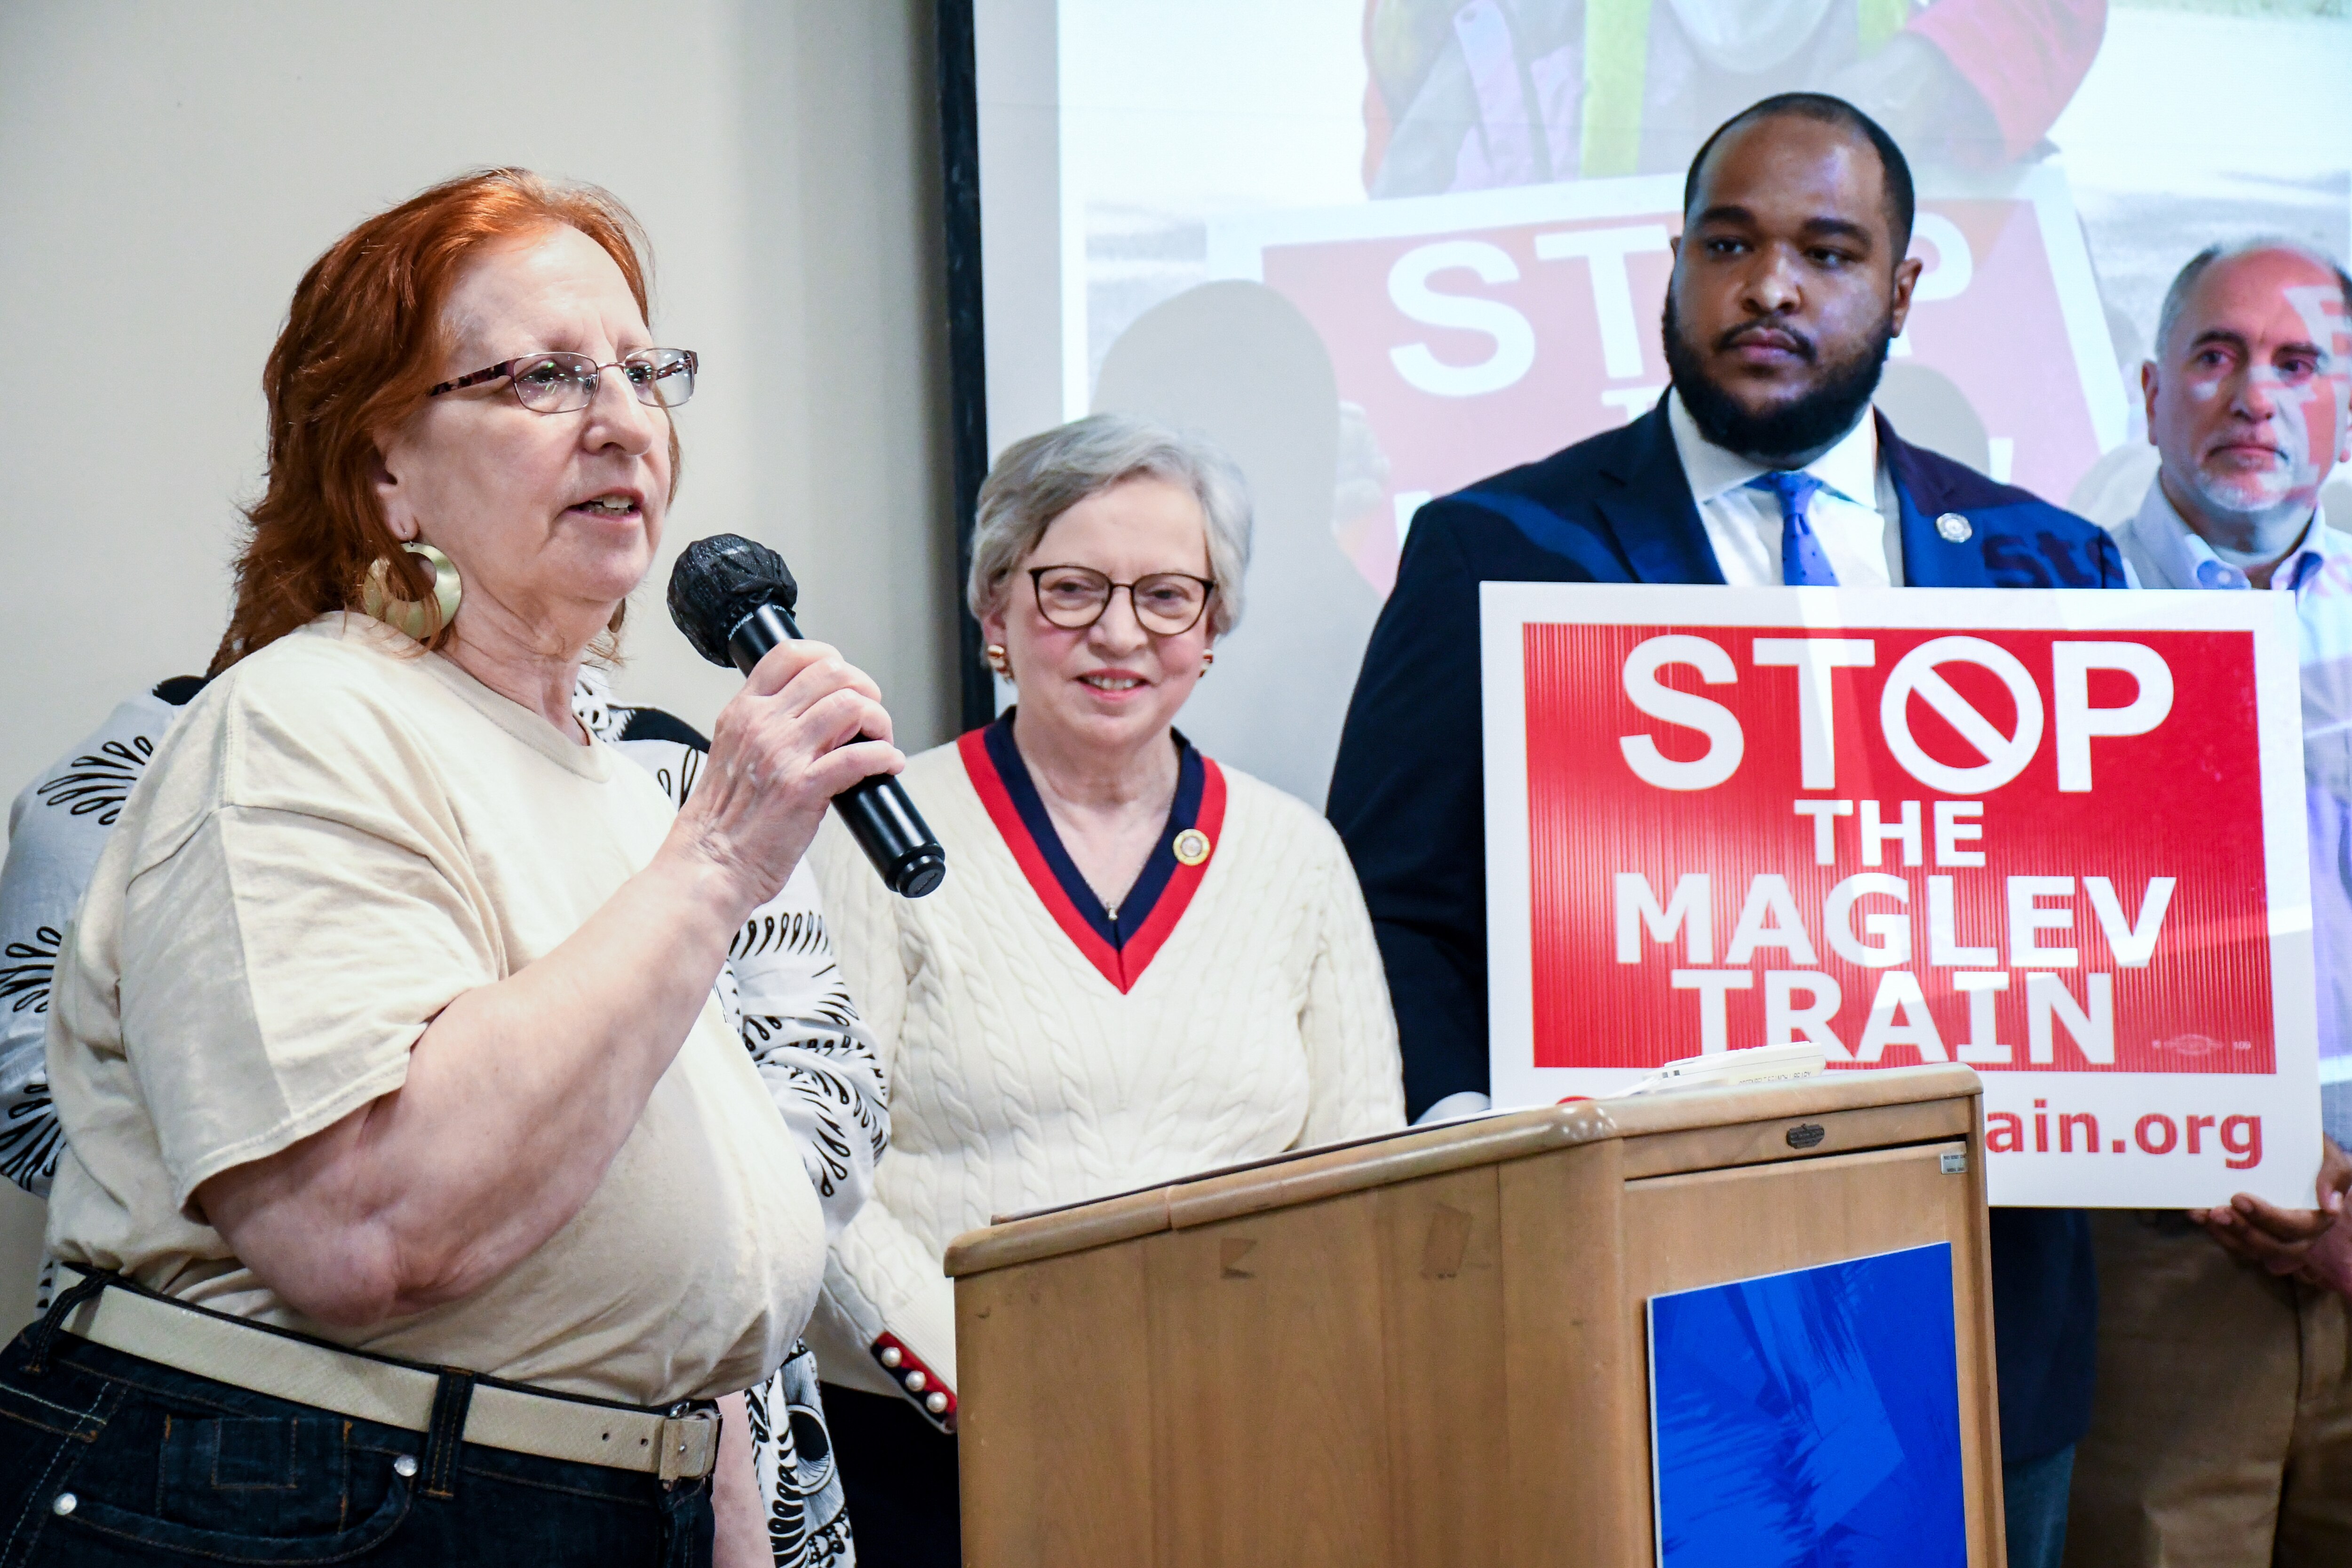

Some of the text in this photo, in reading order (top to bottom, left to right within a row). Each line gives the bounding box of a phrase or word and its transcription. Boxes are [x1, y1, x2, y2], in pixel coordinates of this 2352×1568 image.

[1387, 211, 1973, 398] STP
[1620, 634, 2175, 795] STOP
[1794, 799, 1986, 867] THE
[1616, 871, 2177, 969] MAGLEV
[1671, 969, 2116, 1064] TRAIN
